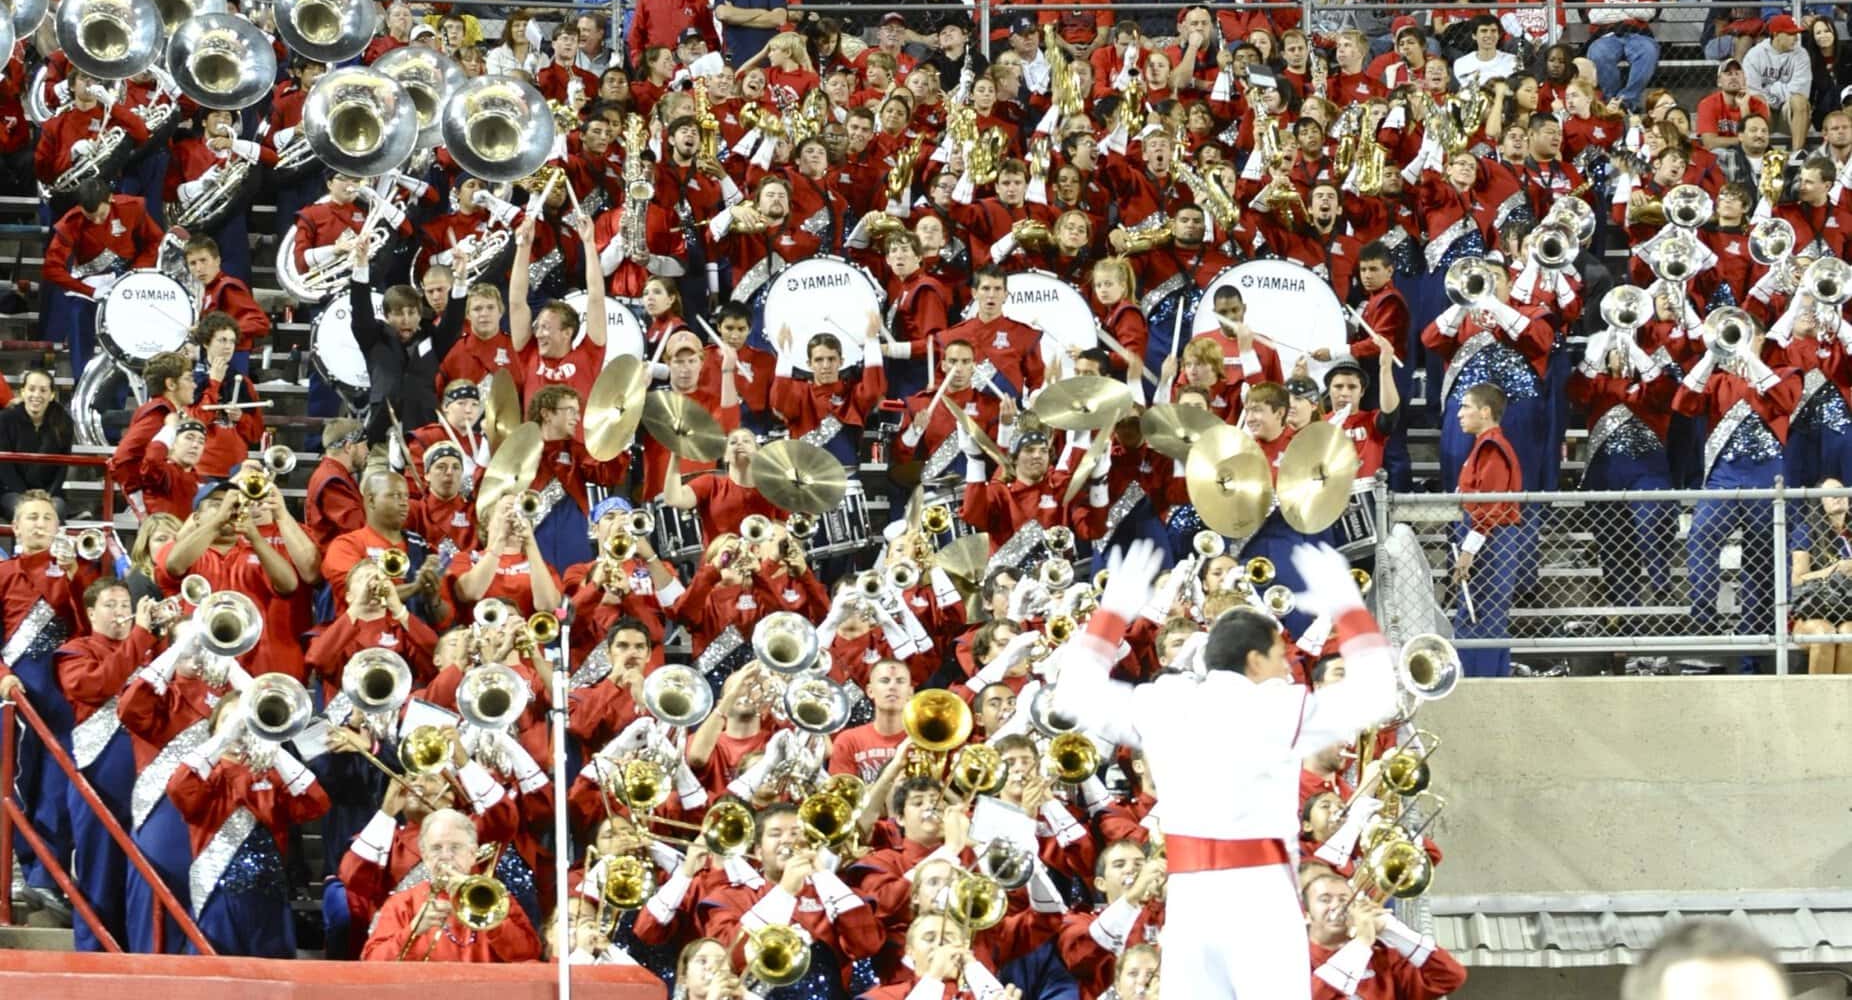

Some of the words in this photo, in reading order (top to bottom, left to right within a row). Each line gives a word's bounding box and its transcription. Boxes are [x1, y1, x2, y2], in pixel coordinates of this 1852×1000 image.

[801, 272, 851, 290] YAMAHA
[1256, 276, 1306, 292] YAMAHA
[135, 289, 176, 301] YAMAHA
[1008, 289, 1060, 305] YAMAHA
